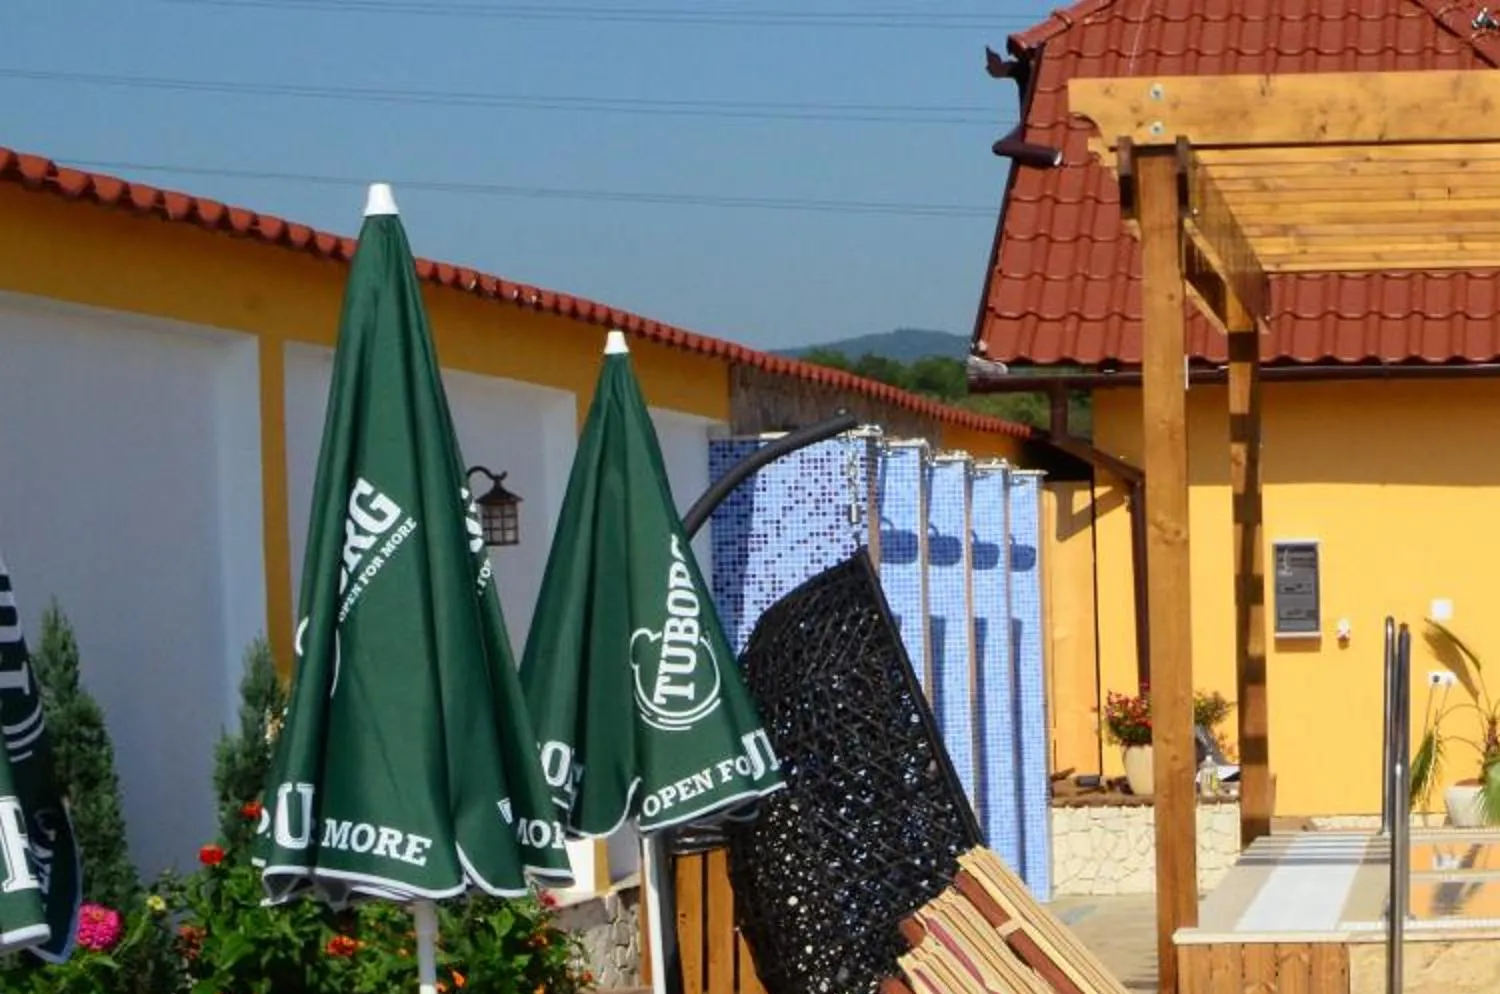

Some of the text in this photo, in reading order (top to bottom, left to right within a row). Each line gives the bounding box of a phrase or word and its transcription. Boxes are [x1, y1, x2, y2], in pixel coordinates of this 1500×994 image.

[338, 516, 418, 622] OPEN FOR MORE
[642, 755, 752, 819] OPEN FO
[320, 817, 433, 868] MORE
